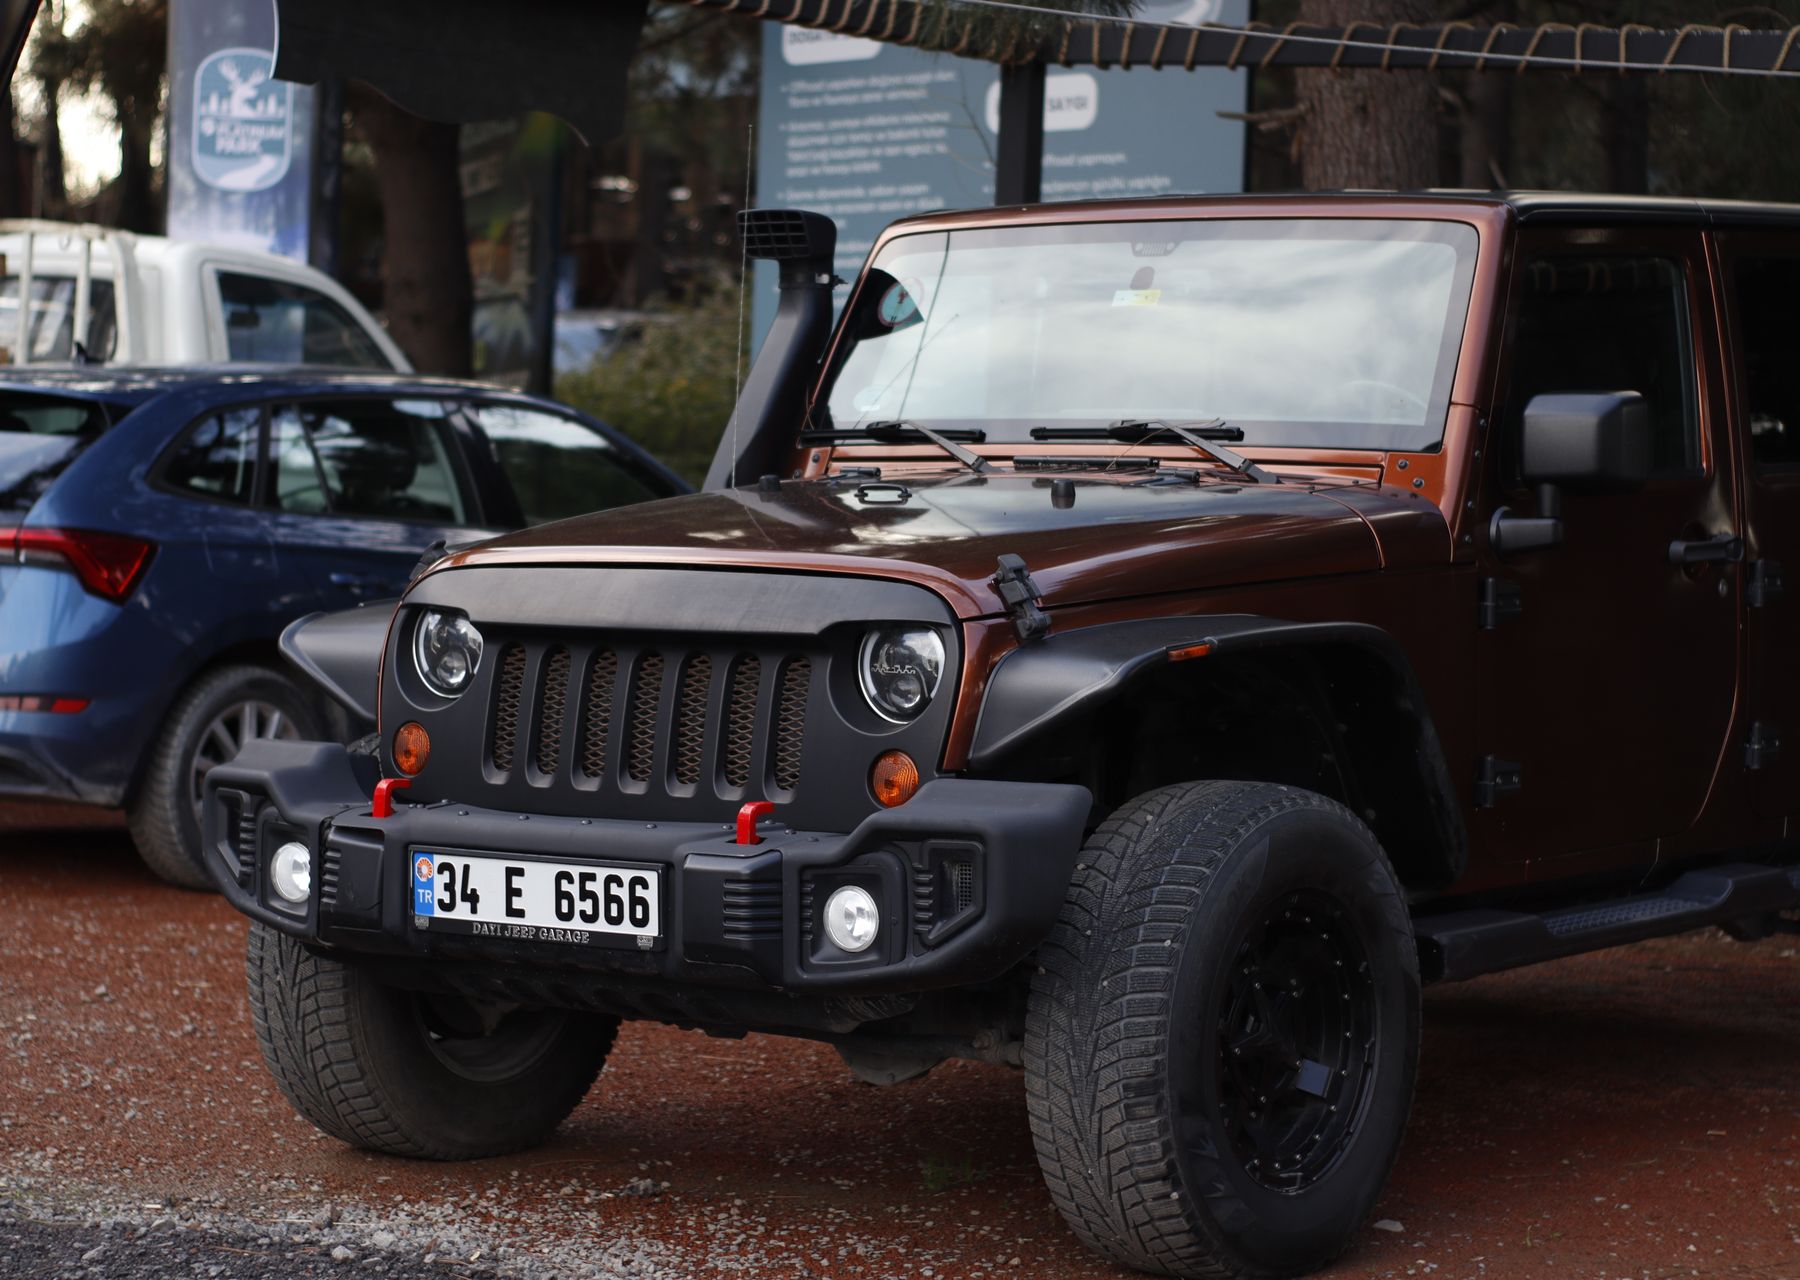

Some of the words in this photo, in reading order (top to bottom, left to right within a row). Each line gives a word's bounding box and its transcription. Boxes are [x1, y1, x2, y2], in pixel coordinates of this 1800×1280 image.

[417, 888, 433, 904] TR
[436, 861, 480, 915] 34
[504, 866, 526, 919] E
[554, 870, 650, 929] 6566
[472, 921, 502, 937] DAYI
[503, 925, 537, 940] JEEP
[538, 927, 591, 944] GARAGE
